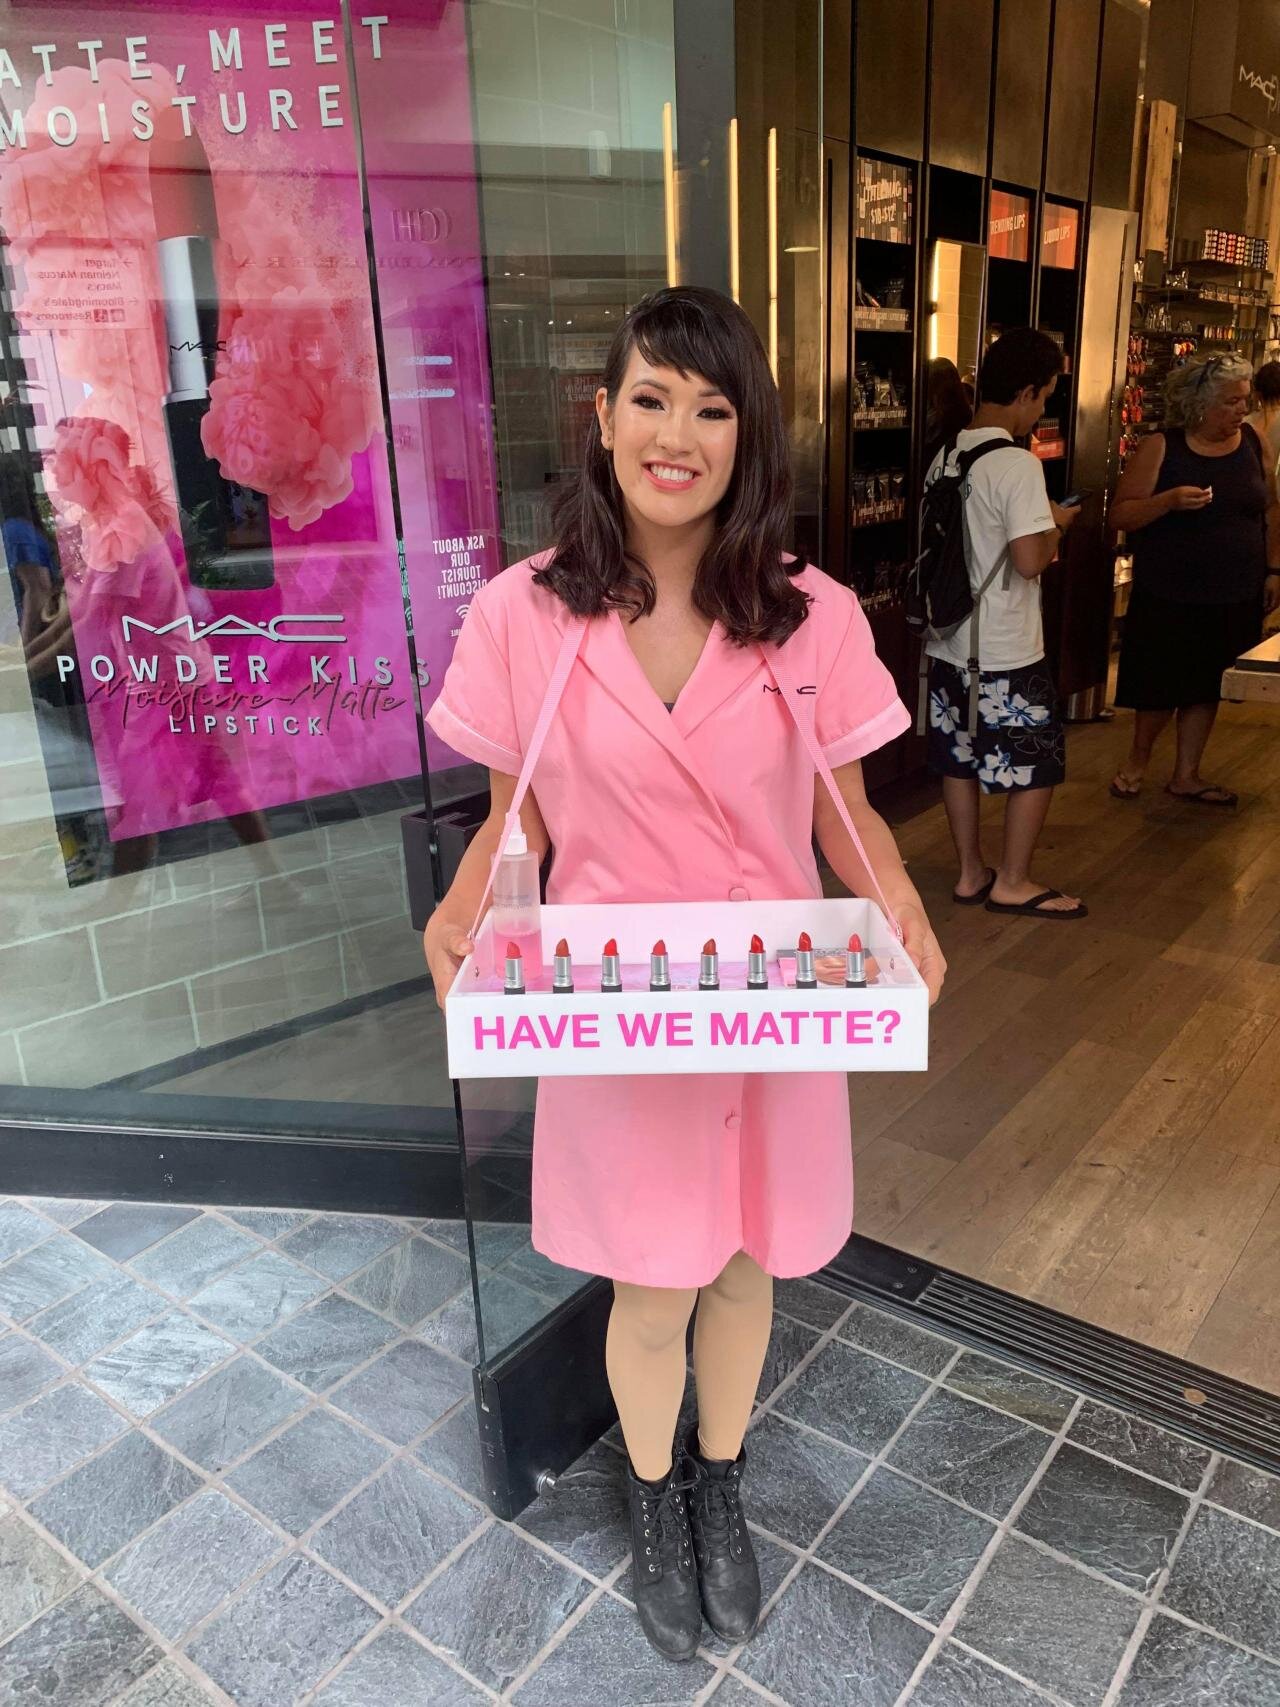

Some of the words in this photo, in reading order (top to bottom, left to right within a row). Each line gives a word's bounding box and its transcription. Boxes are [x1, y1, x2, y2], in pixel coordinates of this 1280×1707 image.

[209, 16, 389, 72] MEET
[0, 85, 345, 151] MOISTURE
[57, 655, 270, 685] POWDER
[311, 655, 431, 688] KISS
[763, 684, 817, 696] MC
[168, 716, 325, 736] LIPSTICK
[473, 1013, 600, 1050] HAVE
[617, 1012, 694, 1047] WE
[710, 1009, 902, 1046] MATTE?
